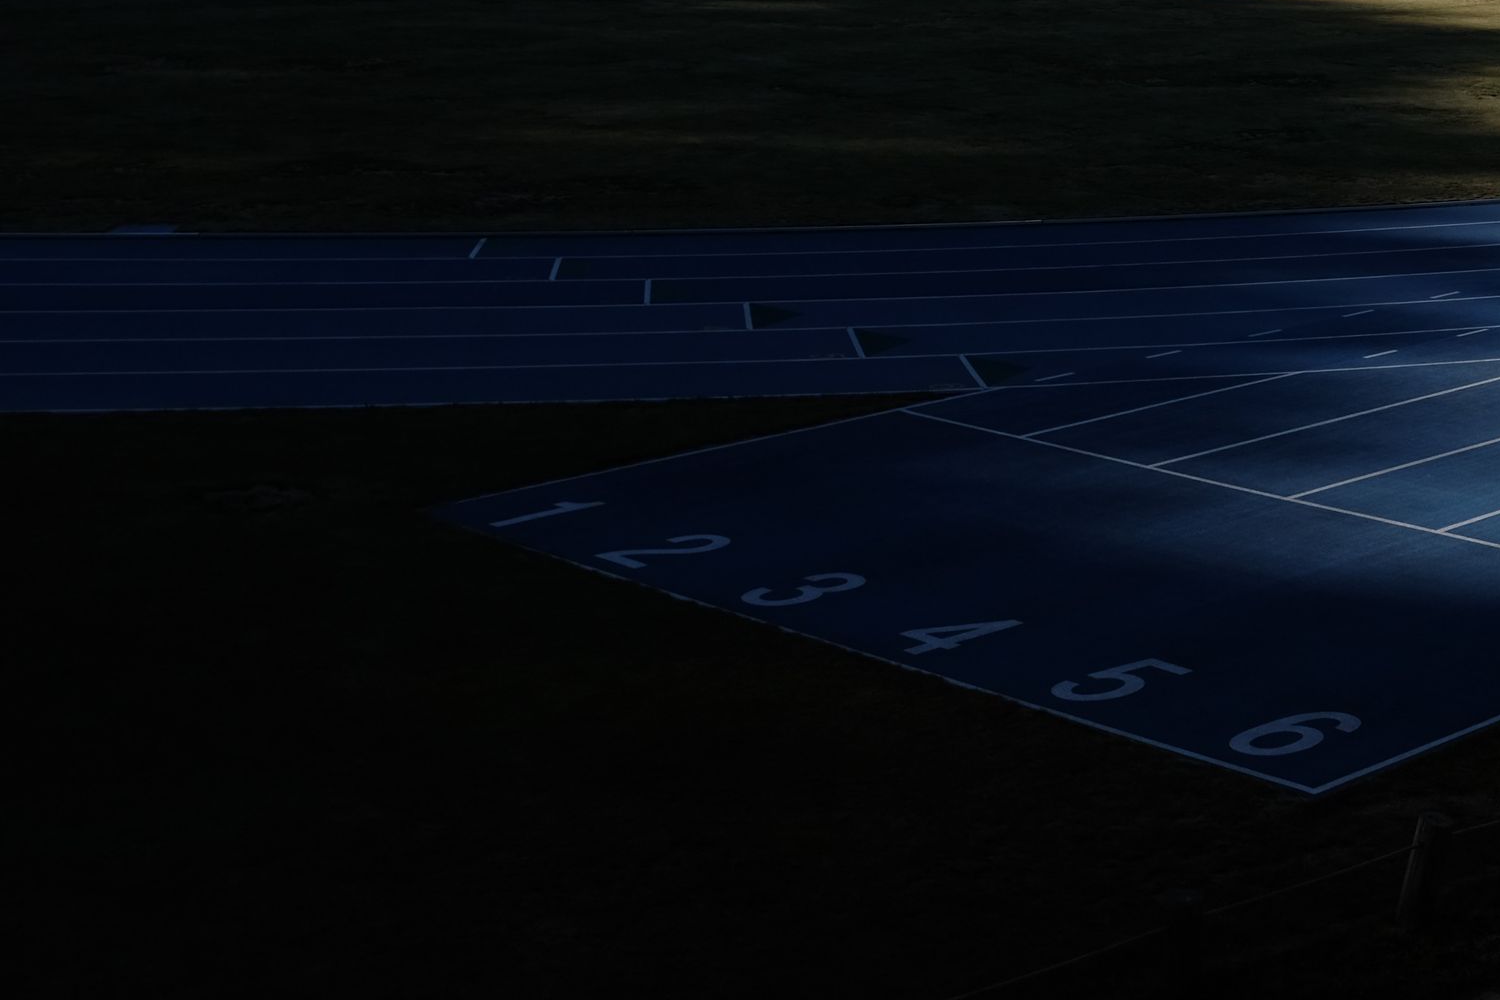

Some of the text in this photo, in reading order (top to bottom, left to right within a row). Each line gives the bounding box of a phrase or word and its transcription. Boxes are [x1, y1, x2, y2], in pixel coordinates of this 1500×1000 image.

[489, 500, 605, 528] 1
[594, 534, 731, 569] 2
[740, 572, 867, 607] 3
[899, 619, 1024, 655] 4
[1050, 657, 1193, 702] 5
[1228, 711, 1362, 756] 6
